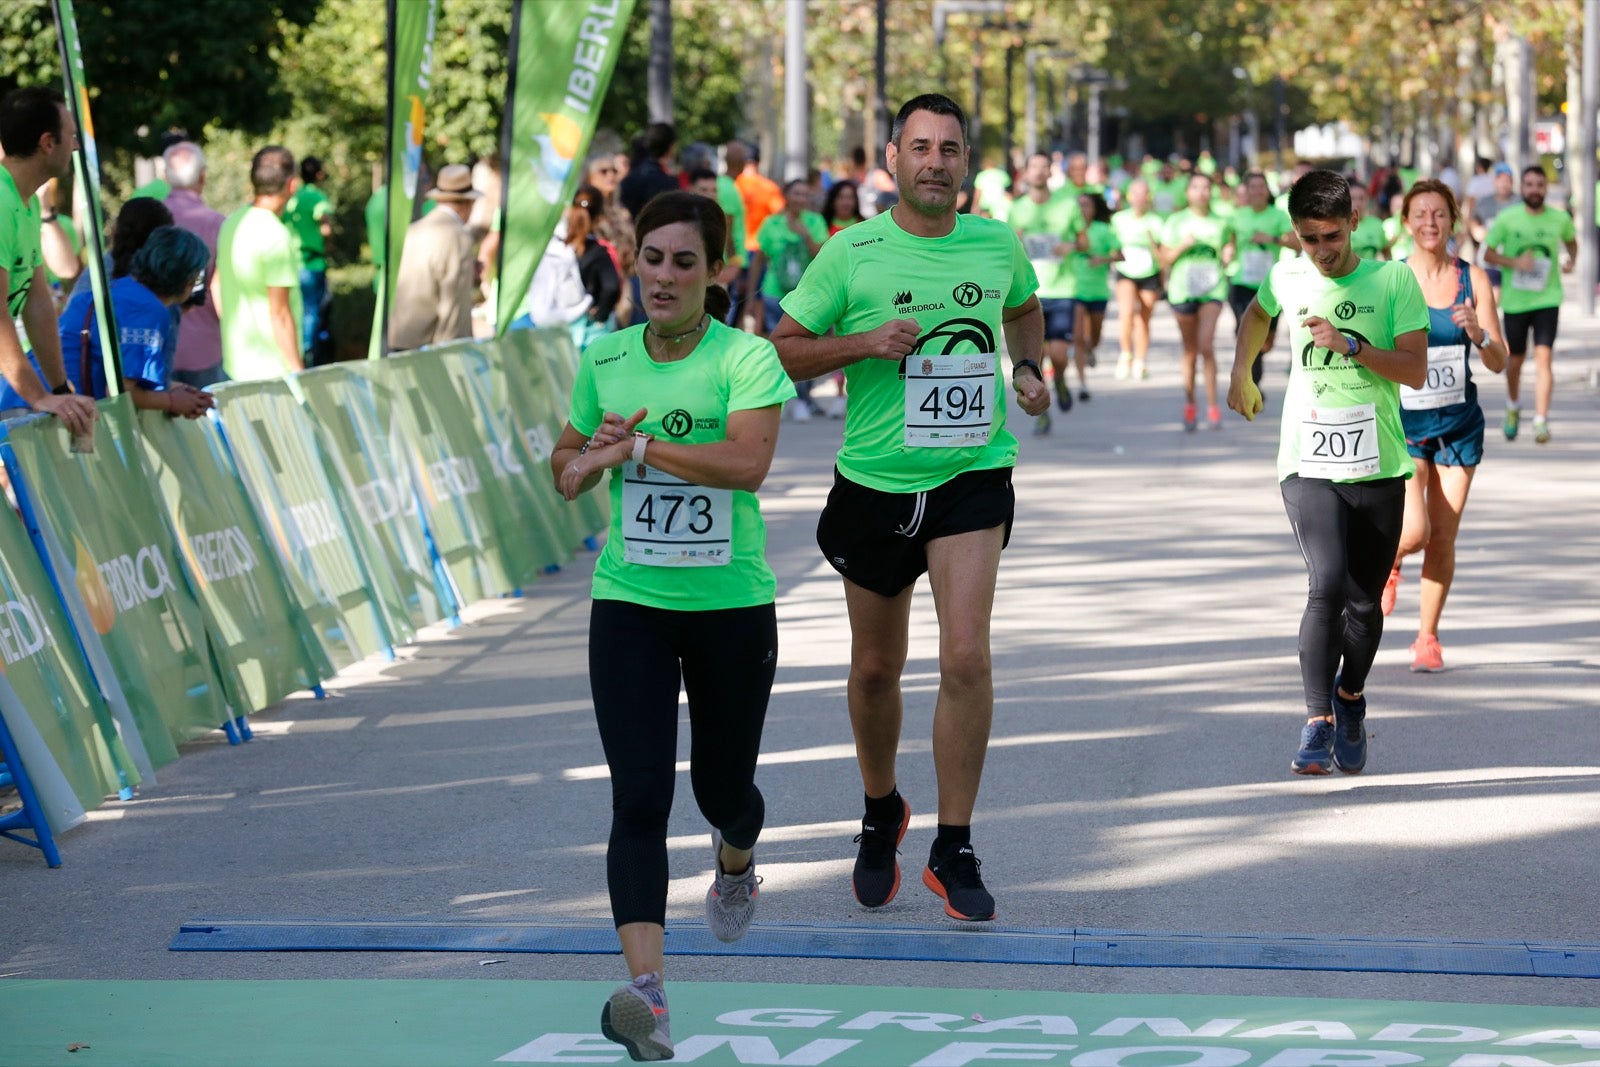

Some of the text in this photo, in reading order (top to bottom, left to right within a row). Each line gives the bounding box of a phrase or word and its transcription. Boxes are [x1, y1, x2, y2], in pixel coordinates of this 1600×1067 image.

[898, 303, 945, 314] IBERDROLA
[1426, 366, 1456, 390] 03
[920, 385, 985, 420] 494
[1312, 429, 1364, 457] 207
[636, 494, 713, 535] 473
[715, 1008, 1600, 1046] GRANADA
[493, 1032, 862, 1066] EN
